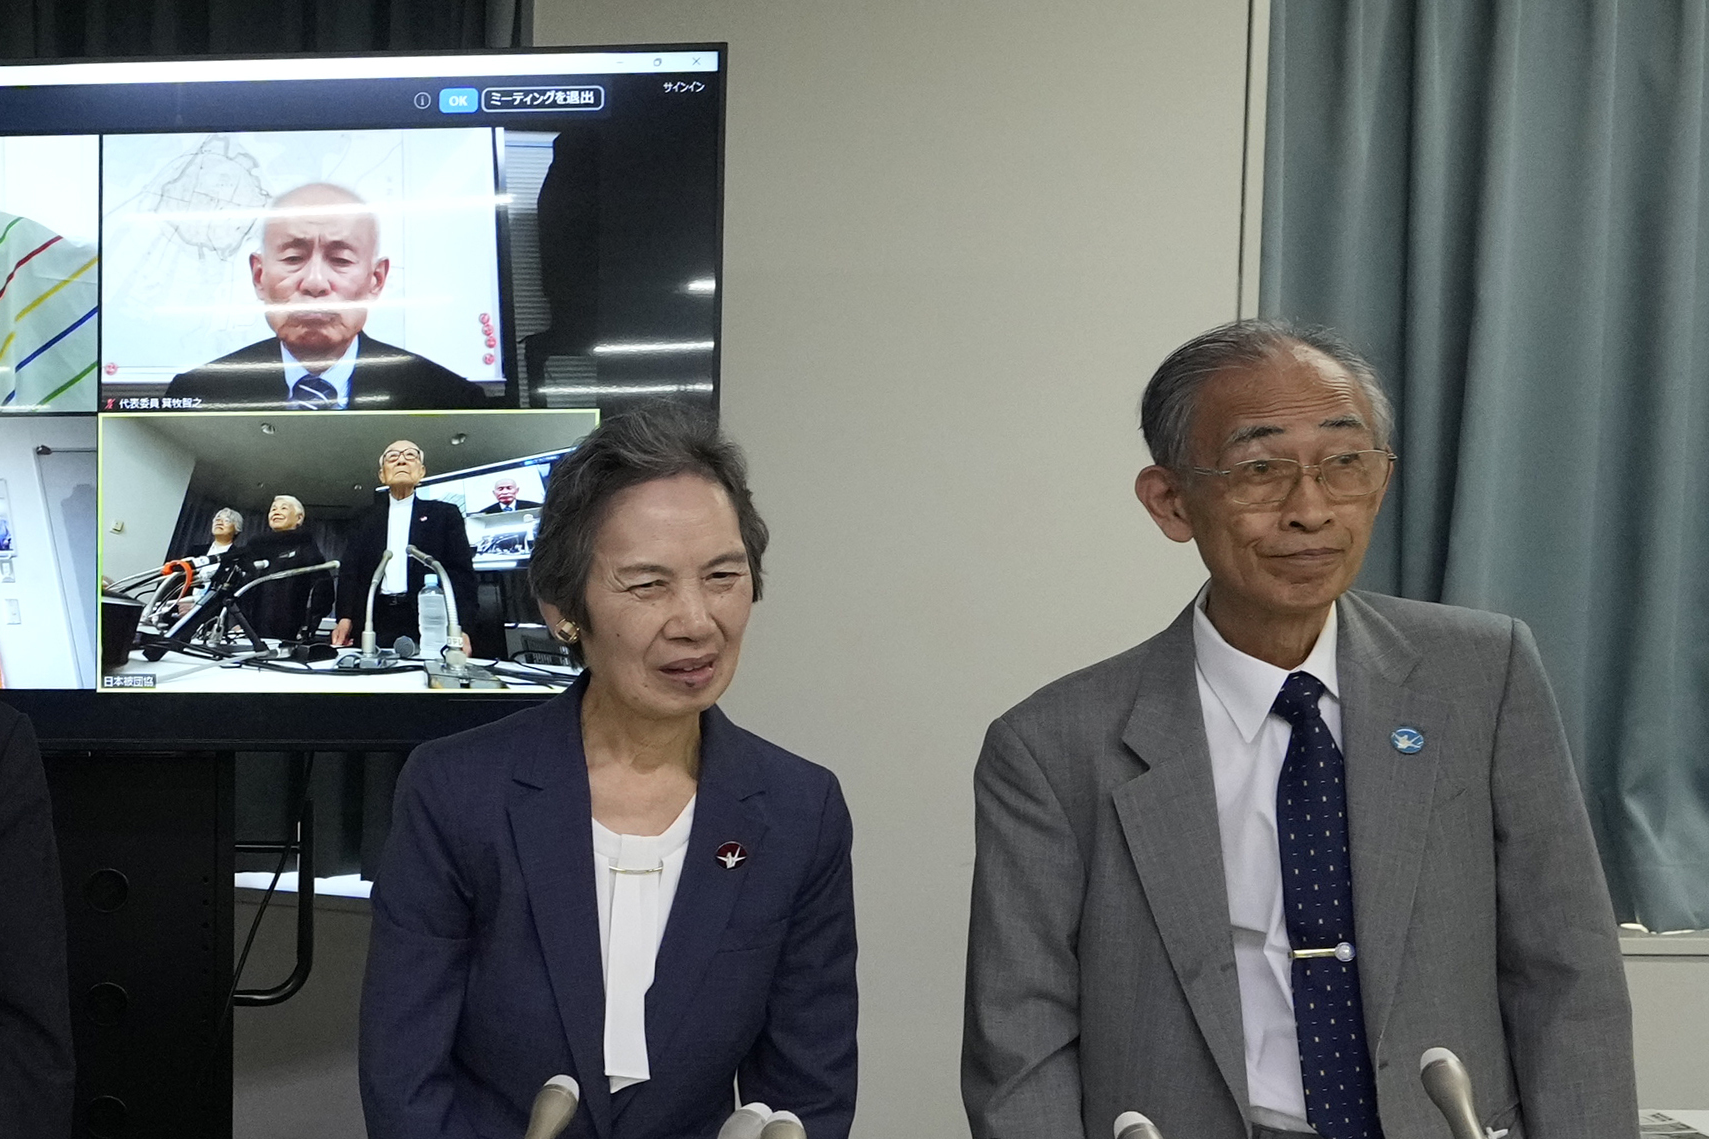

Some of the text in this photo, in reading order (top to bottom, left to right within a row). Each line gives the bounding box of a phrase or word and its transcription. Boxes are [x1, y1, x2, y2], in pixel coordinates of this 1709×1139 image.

[663, 81, 705, 93] サインイン
[448, 95, 468, 107] OK
[490, 91, 594, 106] ミーティングを退出
